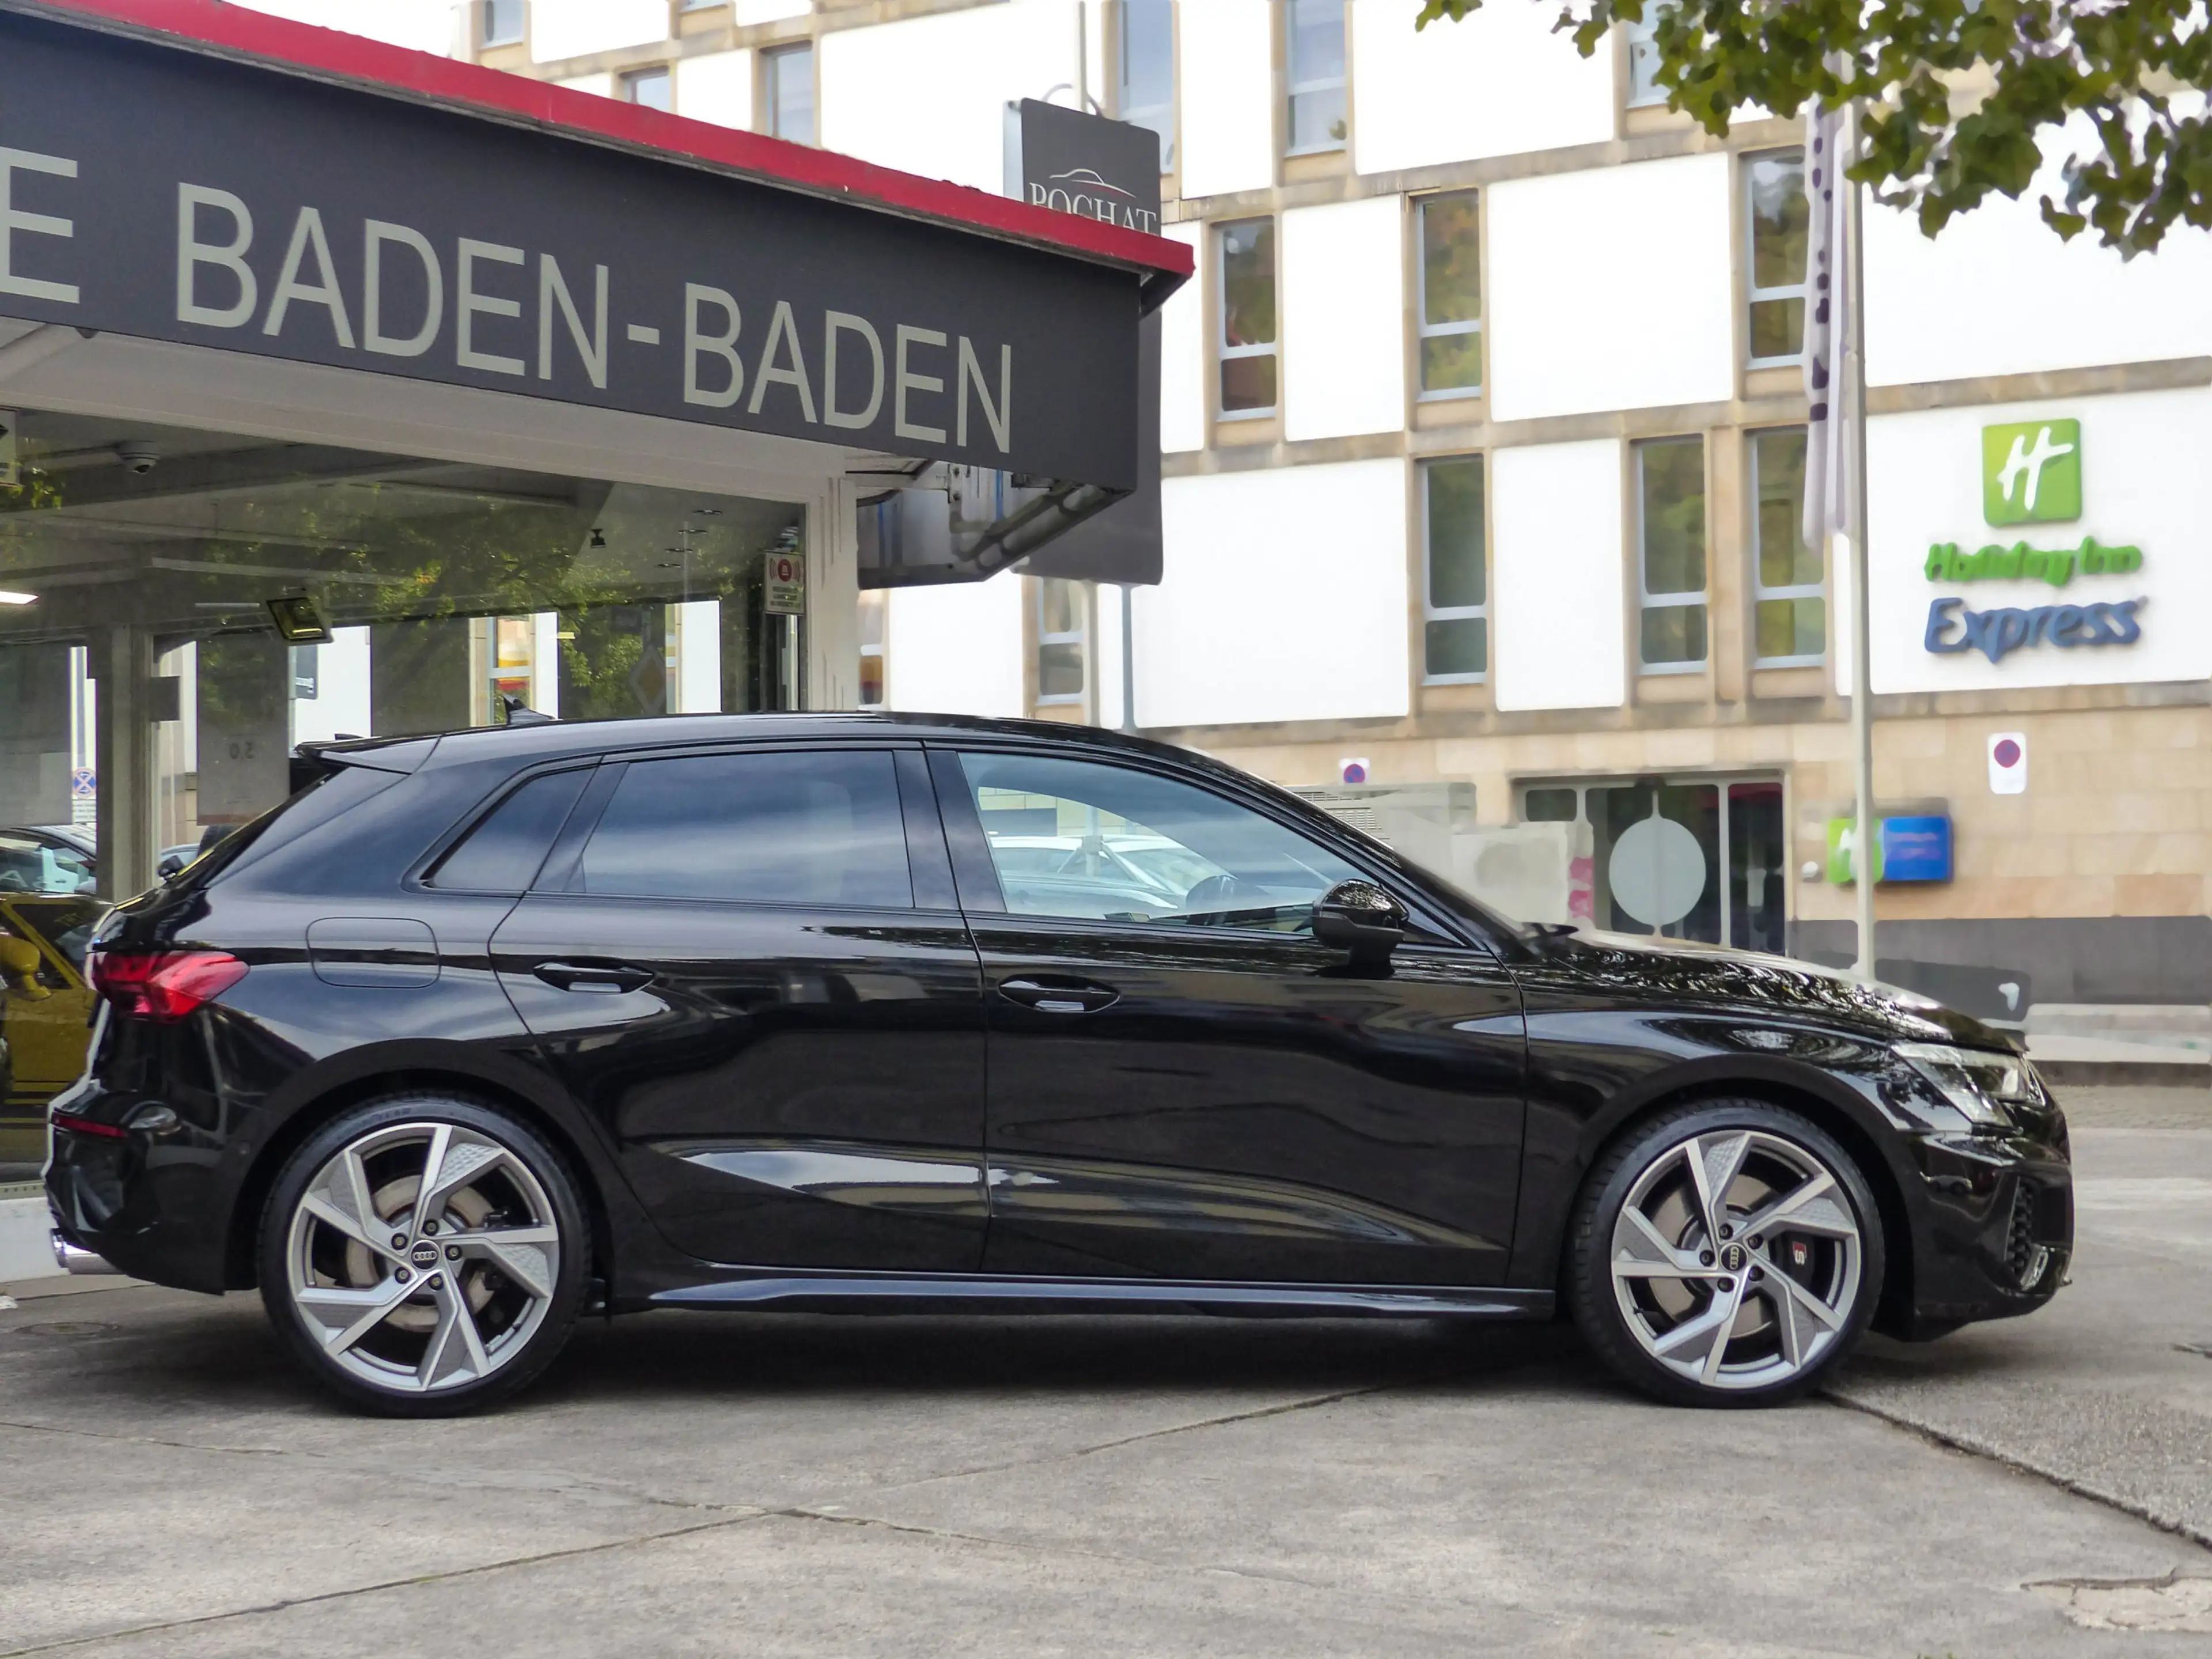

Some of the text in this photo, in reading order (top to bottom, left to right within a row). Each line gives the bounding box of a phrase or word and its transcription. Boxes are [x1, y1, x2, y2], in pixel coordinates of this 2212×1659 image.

[1029, 181, 1157, 237] POCHAT
[176, 181, 1012, 454] BADEN-BADEN
[1924, 597, 2143, 664] Express
